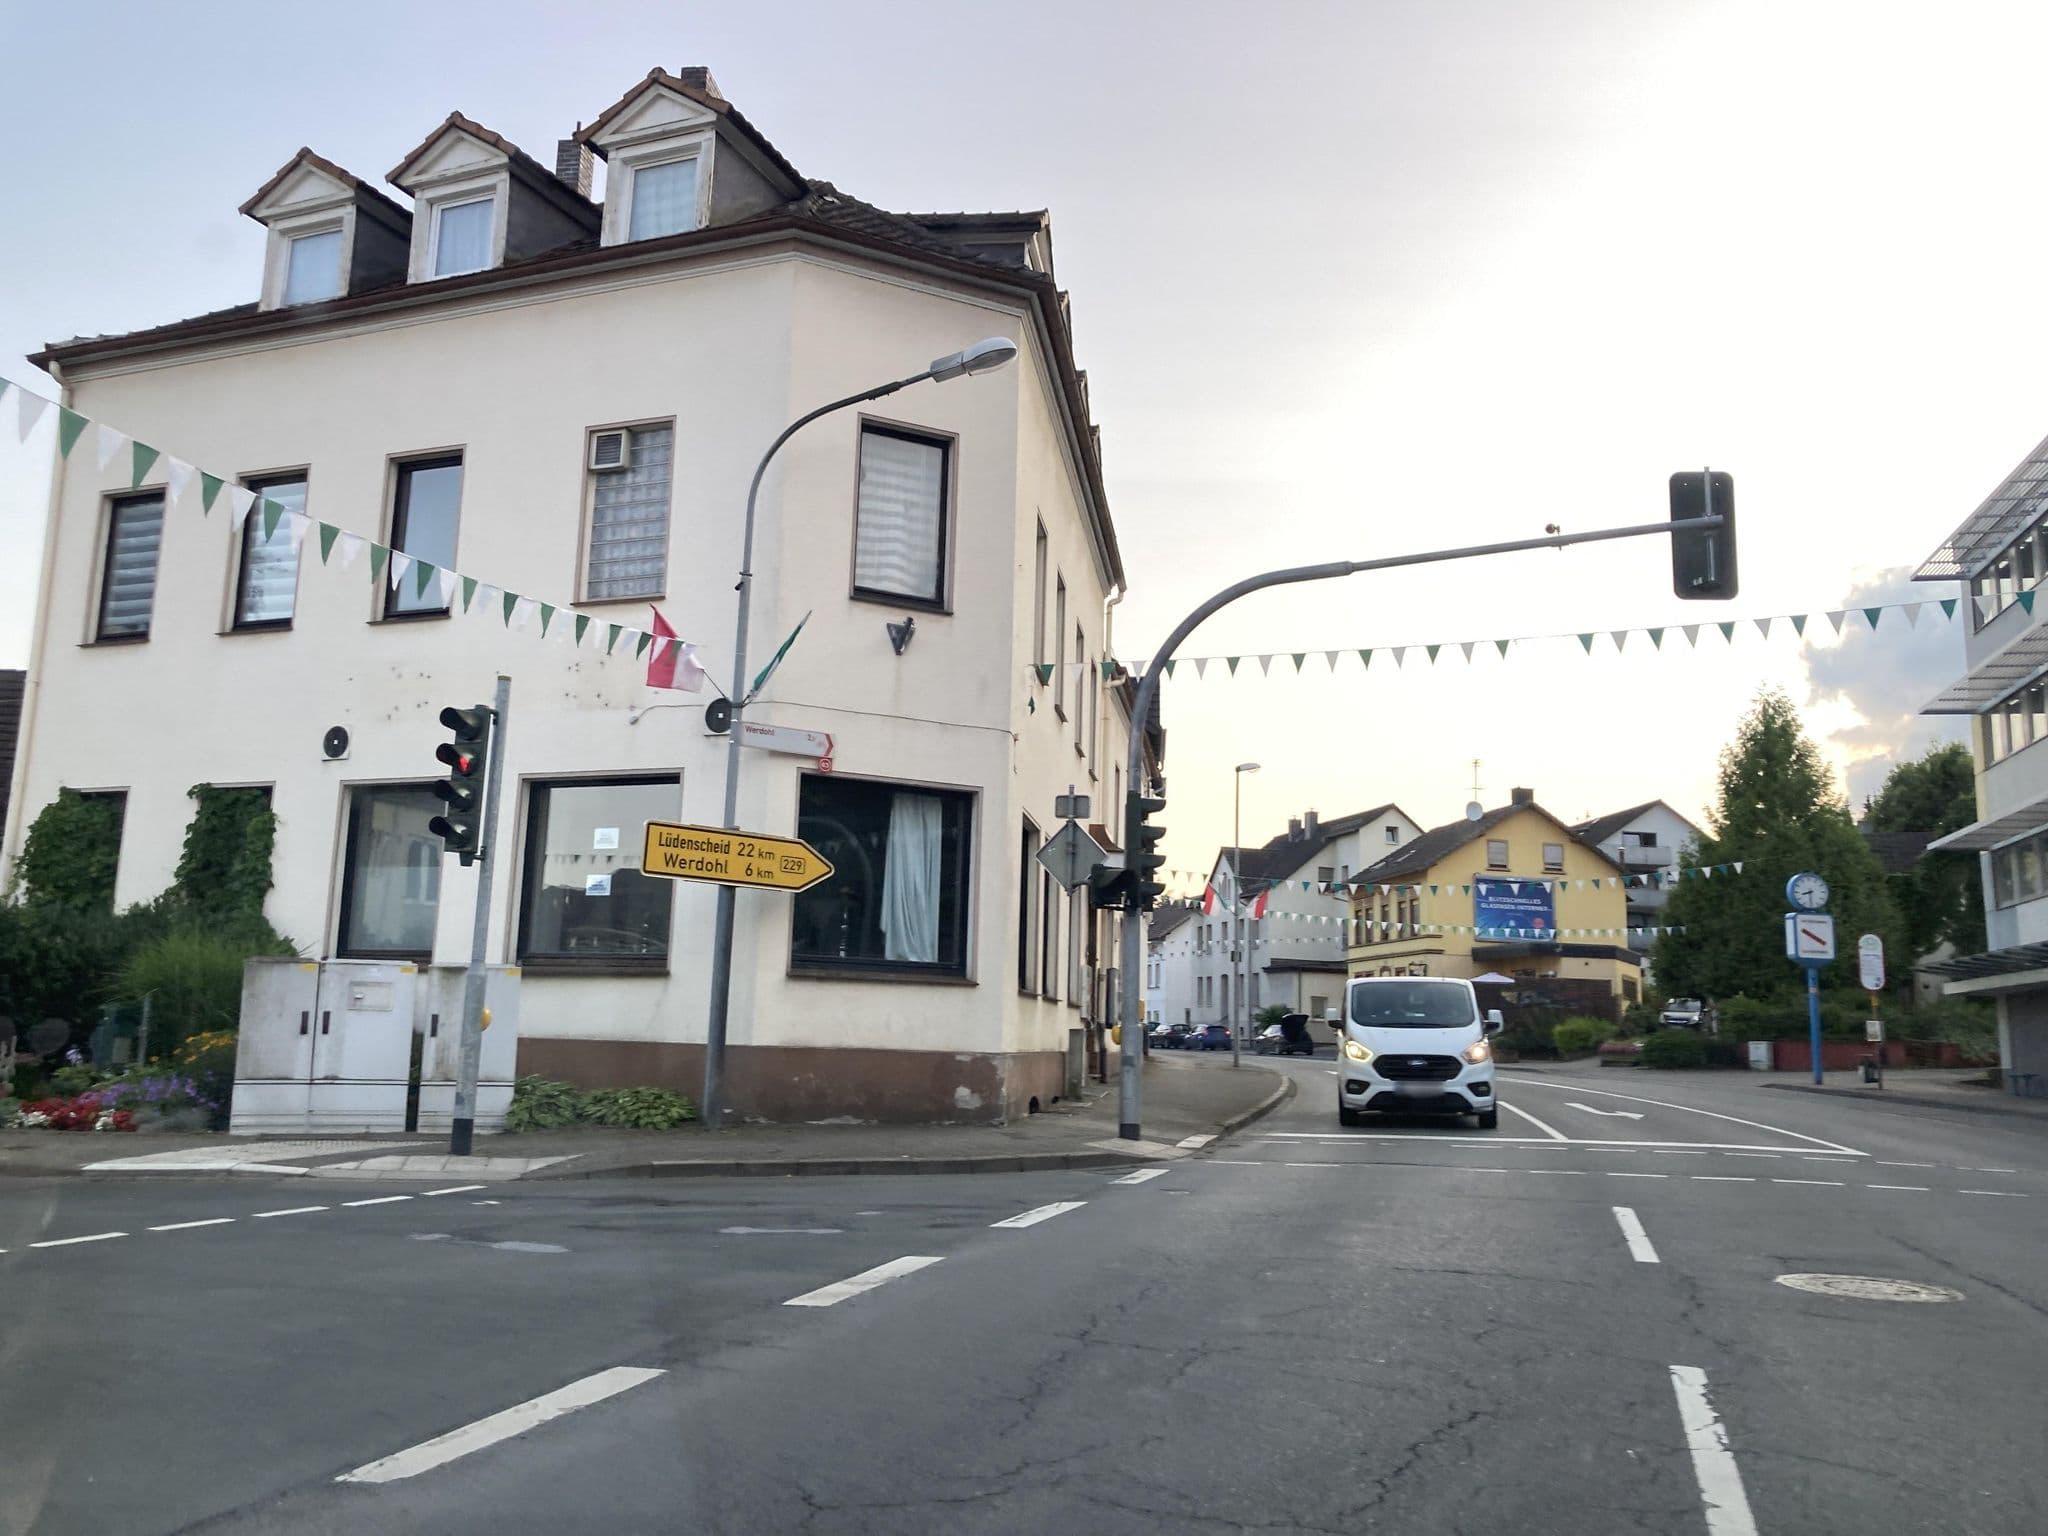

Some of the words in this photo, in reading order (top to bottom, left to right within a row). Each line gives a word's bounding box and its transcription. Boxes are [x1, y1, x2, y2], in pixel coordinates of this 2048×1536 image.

[745, 725, 775, 736] Werdohl
[658, 832, 731, 855] Lüdenscheid
[737, 842, 754, 858] 22
[758, 848, 775, 861] km
[664, 852, 729, 874] Werdohl
[745, 863, 753, 877] 6
[757, 868, 774, 879] km
[783, 859, 803, 871] 229
